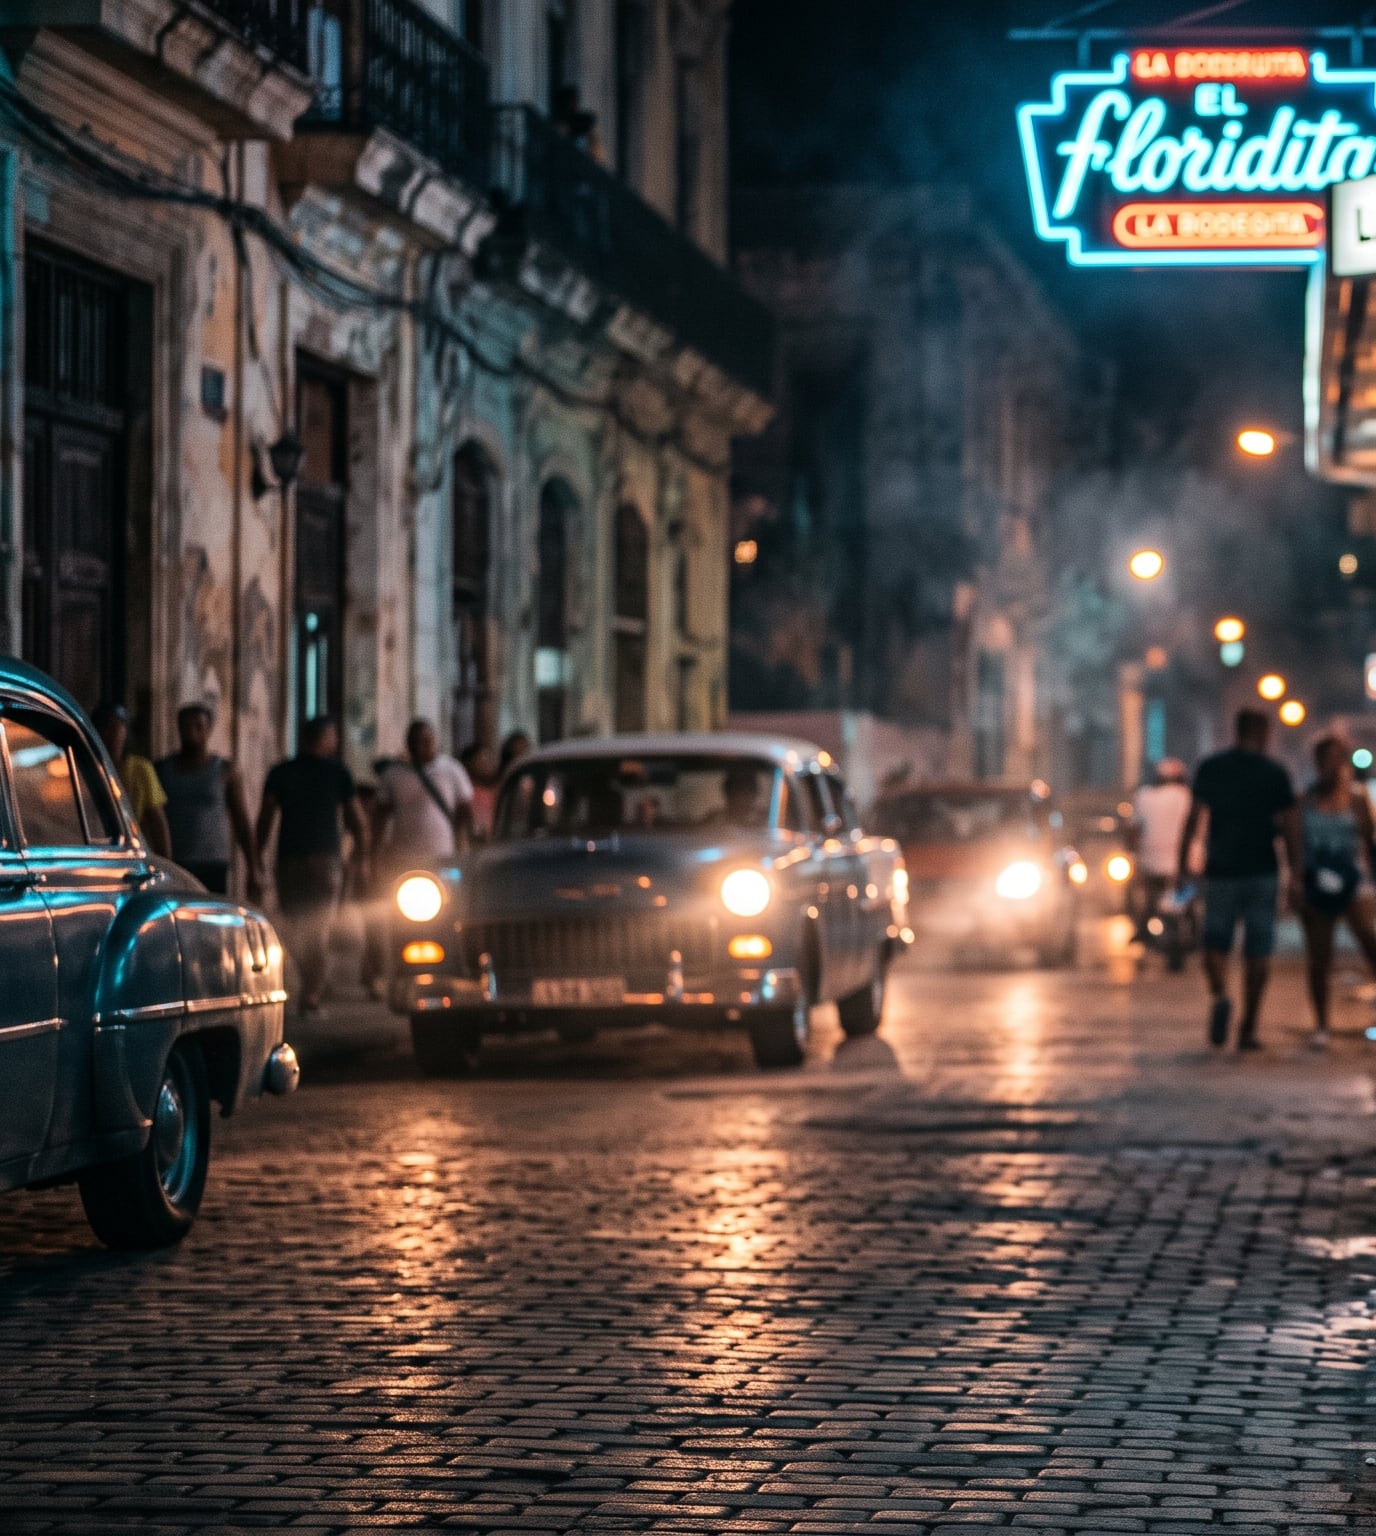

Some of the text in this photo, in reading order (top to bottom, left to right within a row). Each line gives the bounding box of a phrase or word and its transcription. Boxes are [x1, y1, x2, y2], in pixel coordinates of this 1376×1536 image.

[1135, 52, 1171, 78] LA
[1195, 83, 1248, 117] EL
[1135, 212, 1173, 238] LA
